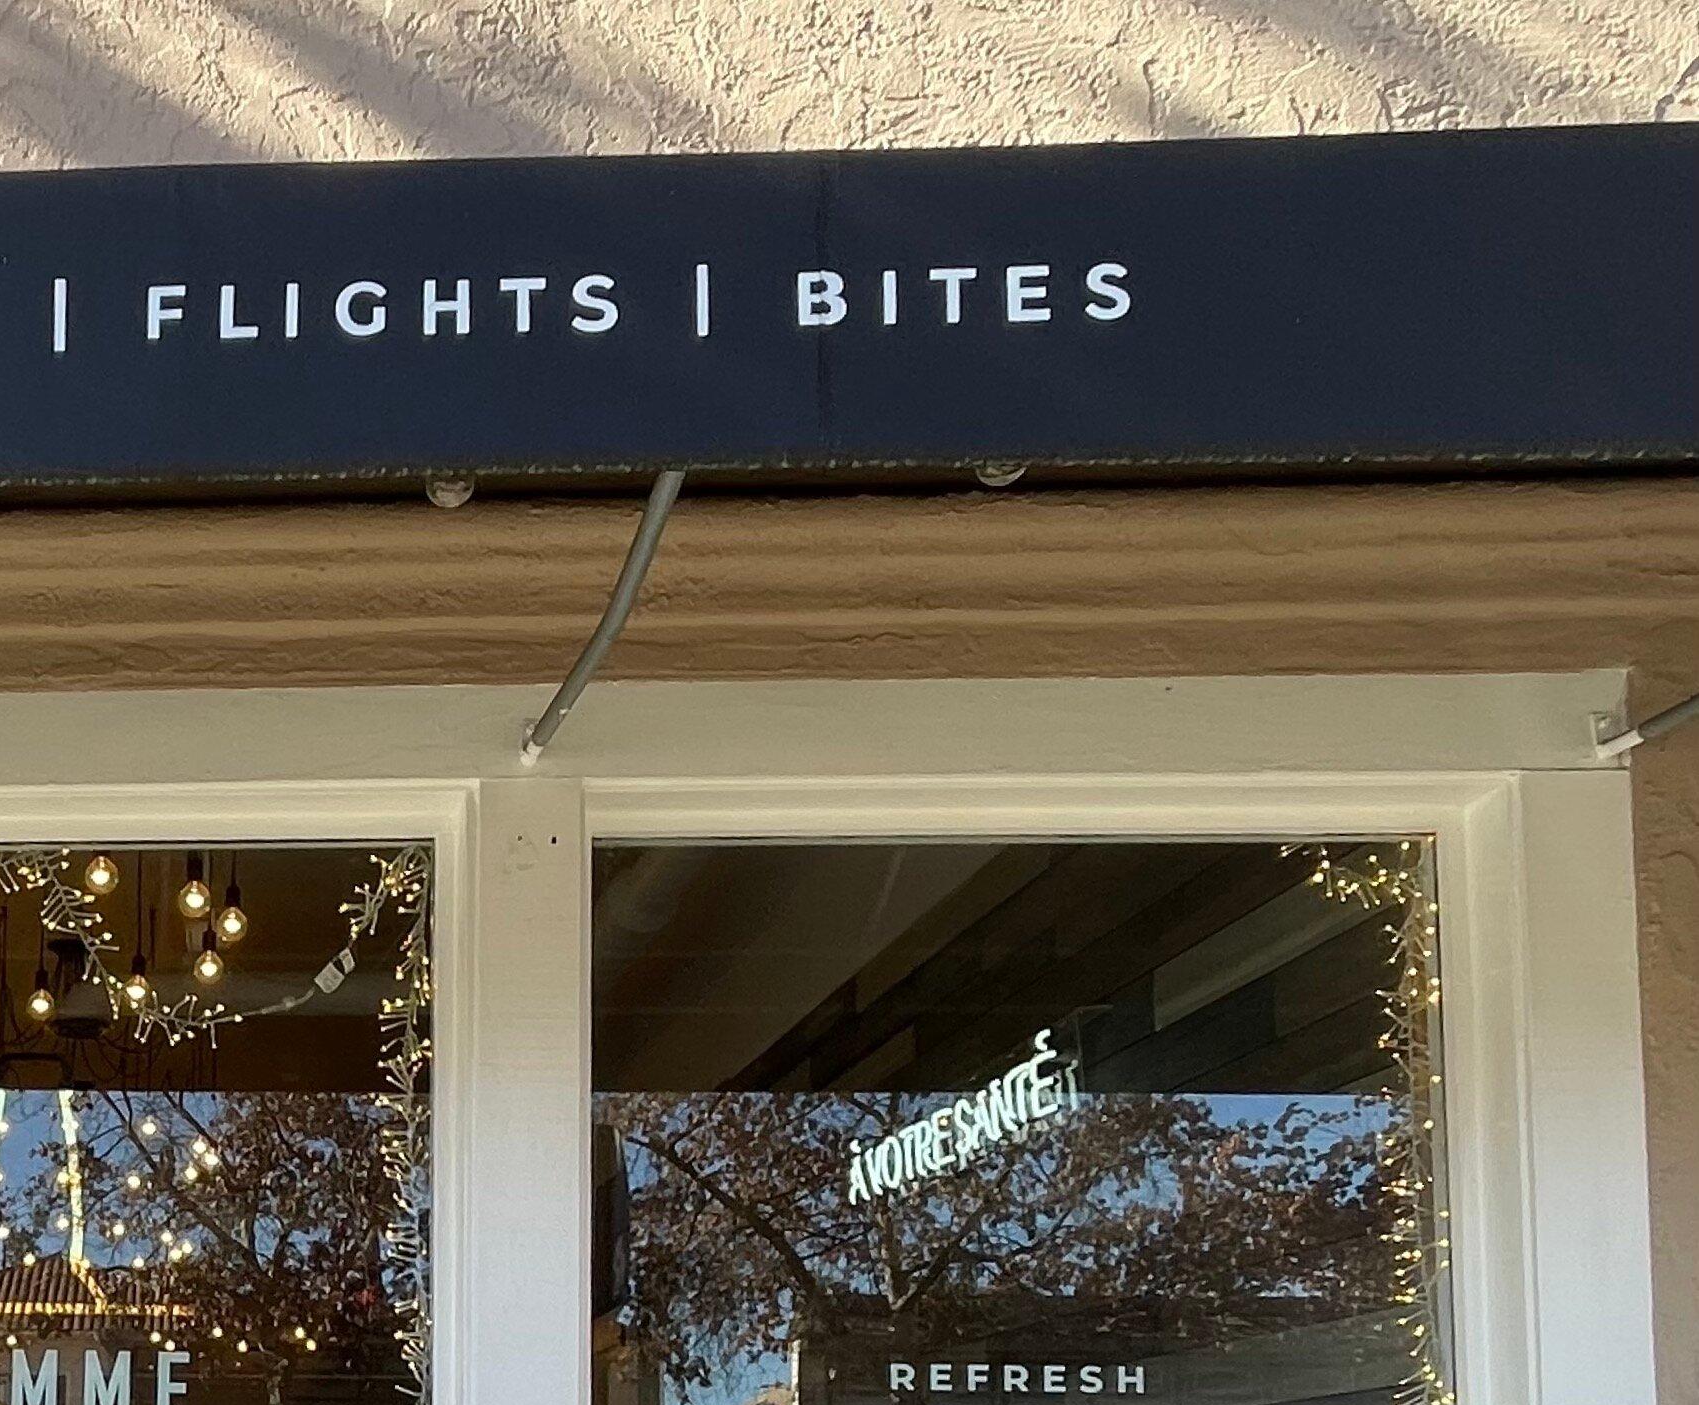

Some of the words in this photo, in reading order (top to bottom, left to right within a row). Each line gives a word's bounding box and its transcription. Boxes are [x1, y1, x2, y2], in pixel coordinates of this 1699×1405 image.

[146, 273, 621, 342] FLIGHTS
[797, 262, 1133, 328] BITES
[889, 1363, 1146, 1394] REFRESH
